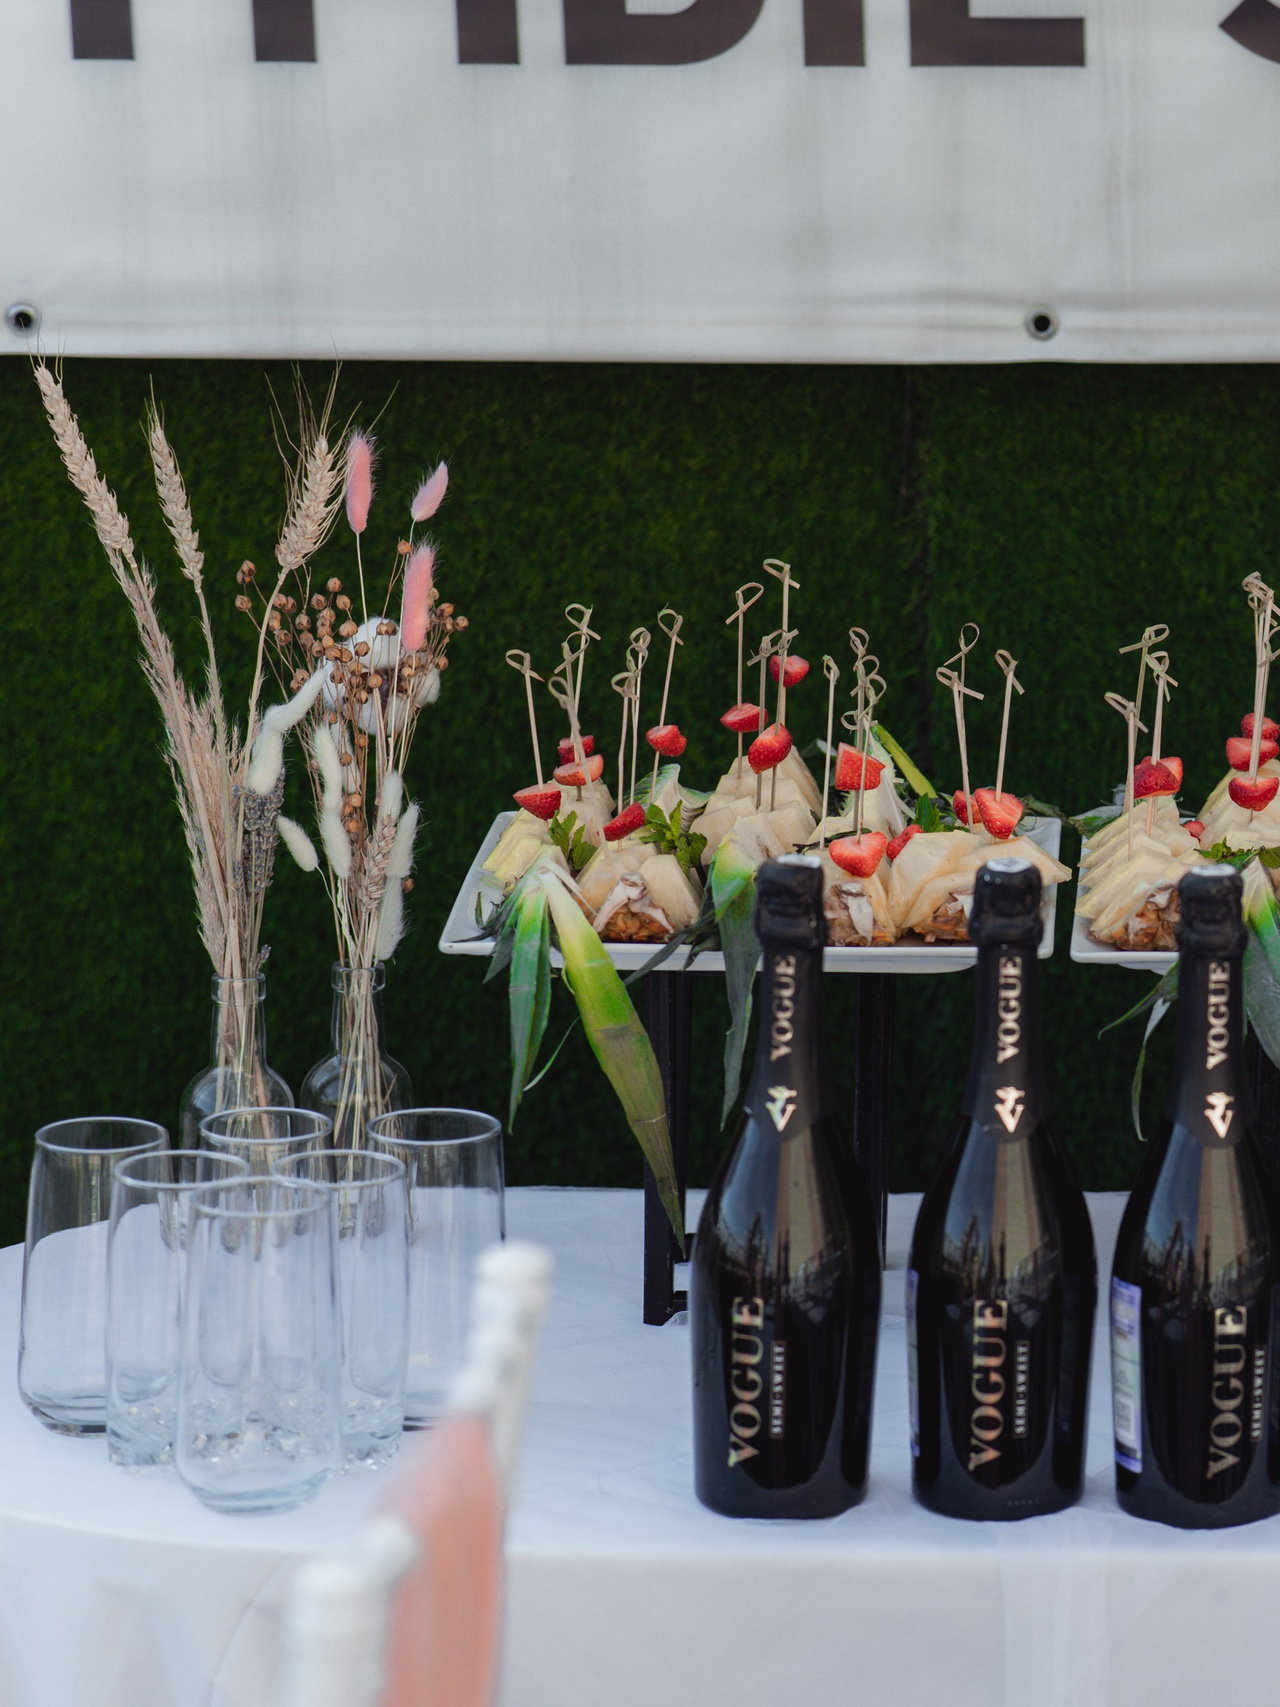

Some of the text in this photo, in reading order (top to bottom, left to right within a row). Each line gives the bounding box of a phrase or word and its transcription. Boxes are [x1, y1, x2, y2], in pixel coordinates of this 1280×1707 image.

[770, 955, 796, 1061] VOGUE
[996, 956, 1022, 1063] VOGUE
[1206, 961, 1231, 1070] VOGUE
[728, 1297, 764, 1467] VOGUE
[968, 1299, 1008, 1471] VOGUE
[1206, 1305, 1247, 1479] VOGUE
